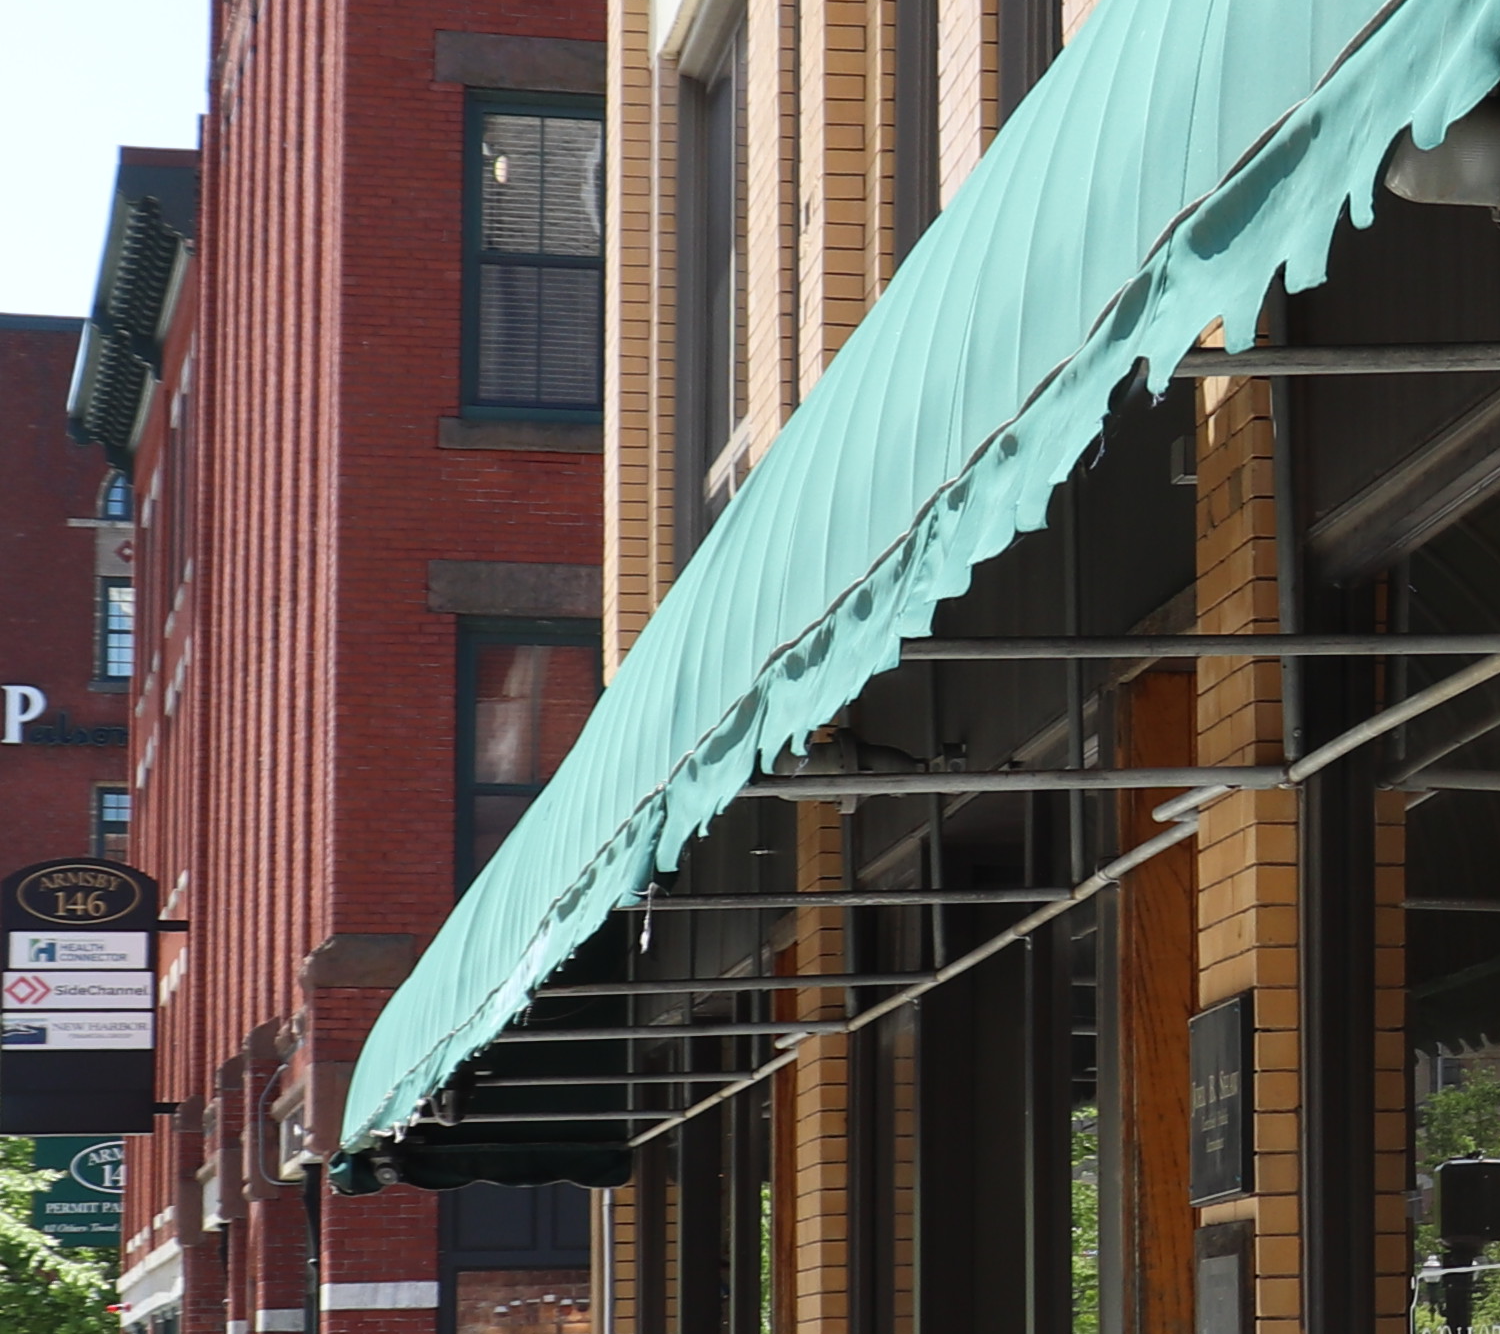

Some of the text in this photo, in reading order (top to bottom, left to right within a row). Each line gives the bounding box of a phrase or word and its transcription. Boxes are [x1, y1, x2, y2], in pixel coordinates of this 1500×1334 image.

[39, 871, 122, 892] ARMSBY
[54, 890, 107, 917] 146
[60, 943, 104, 952] HEALTH
[59, 953, 127, 961] CONNECTOR
[54, 985, 149, 996] SideChannel
[89, 1022, 148, 1031] HARBOR
[46, 1202, 99, 1214] PERMIT
